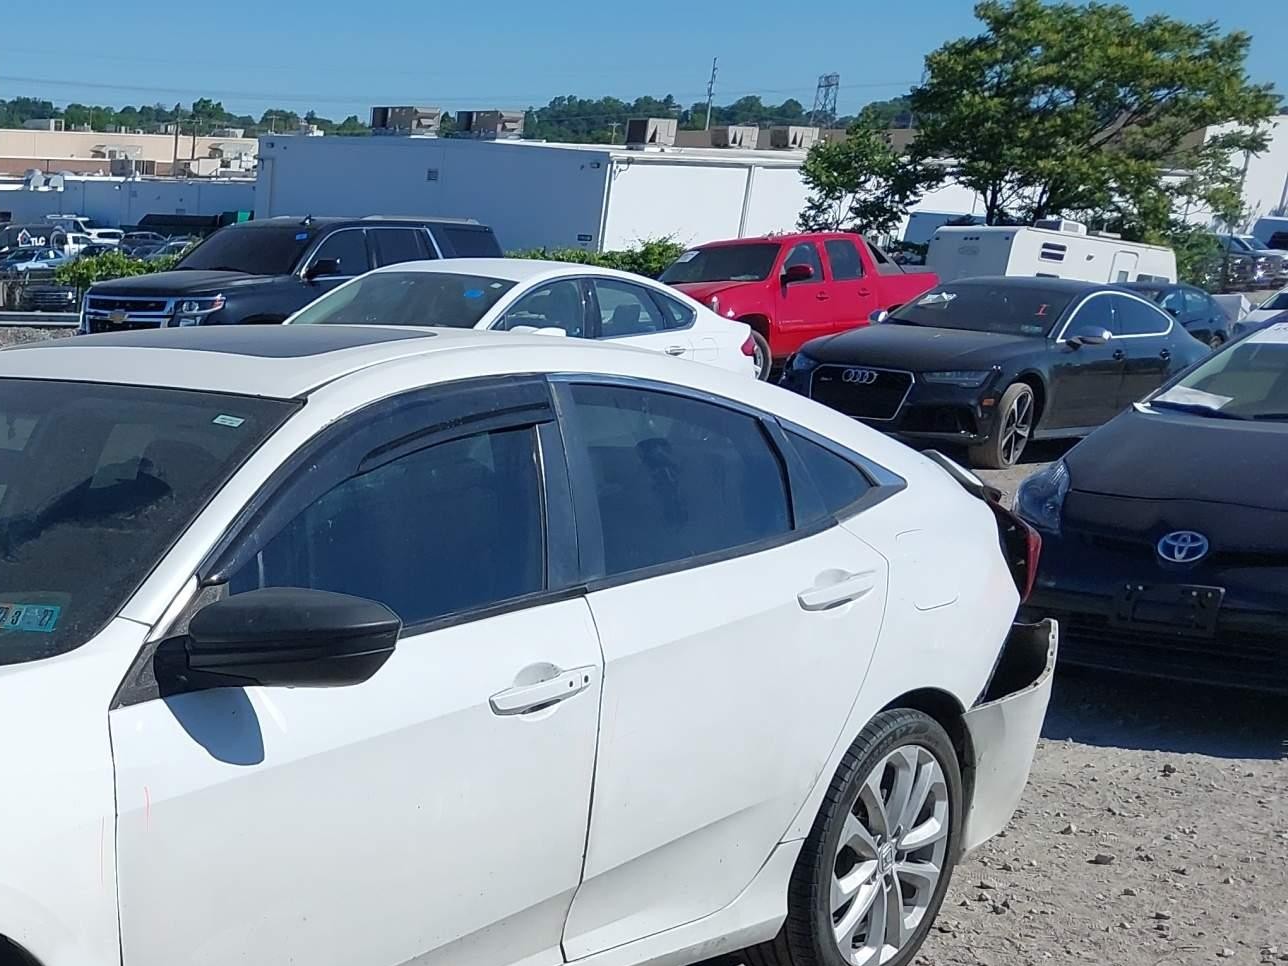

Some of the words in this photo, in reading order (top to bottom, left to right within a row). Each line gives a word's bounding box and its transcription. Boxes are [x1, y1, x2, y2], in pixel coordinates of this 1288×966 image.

[30, 236, 46, 246] TLC
[11, 610, 22, 625] 3
[38, 609, 54, 626] 27
